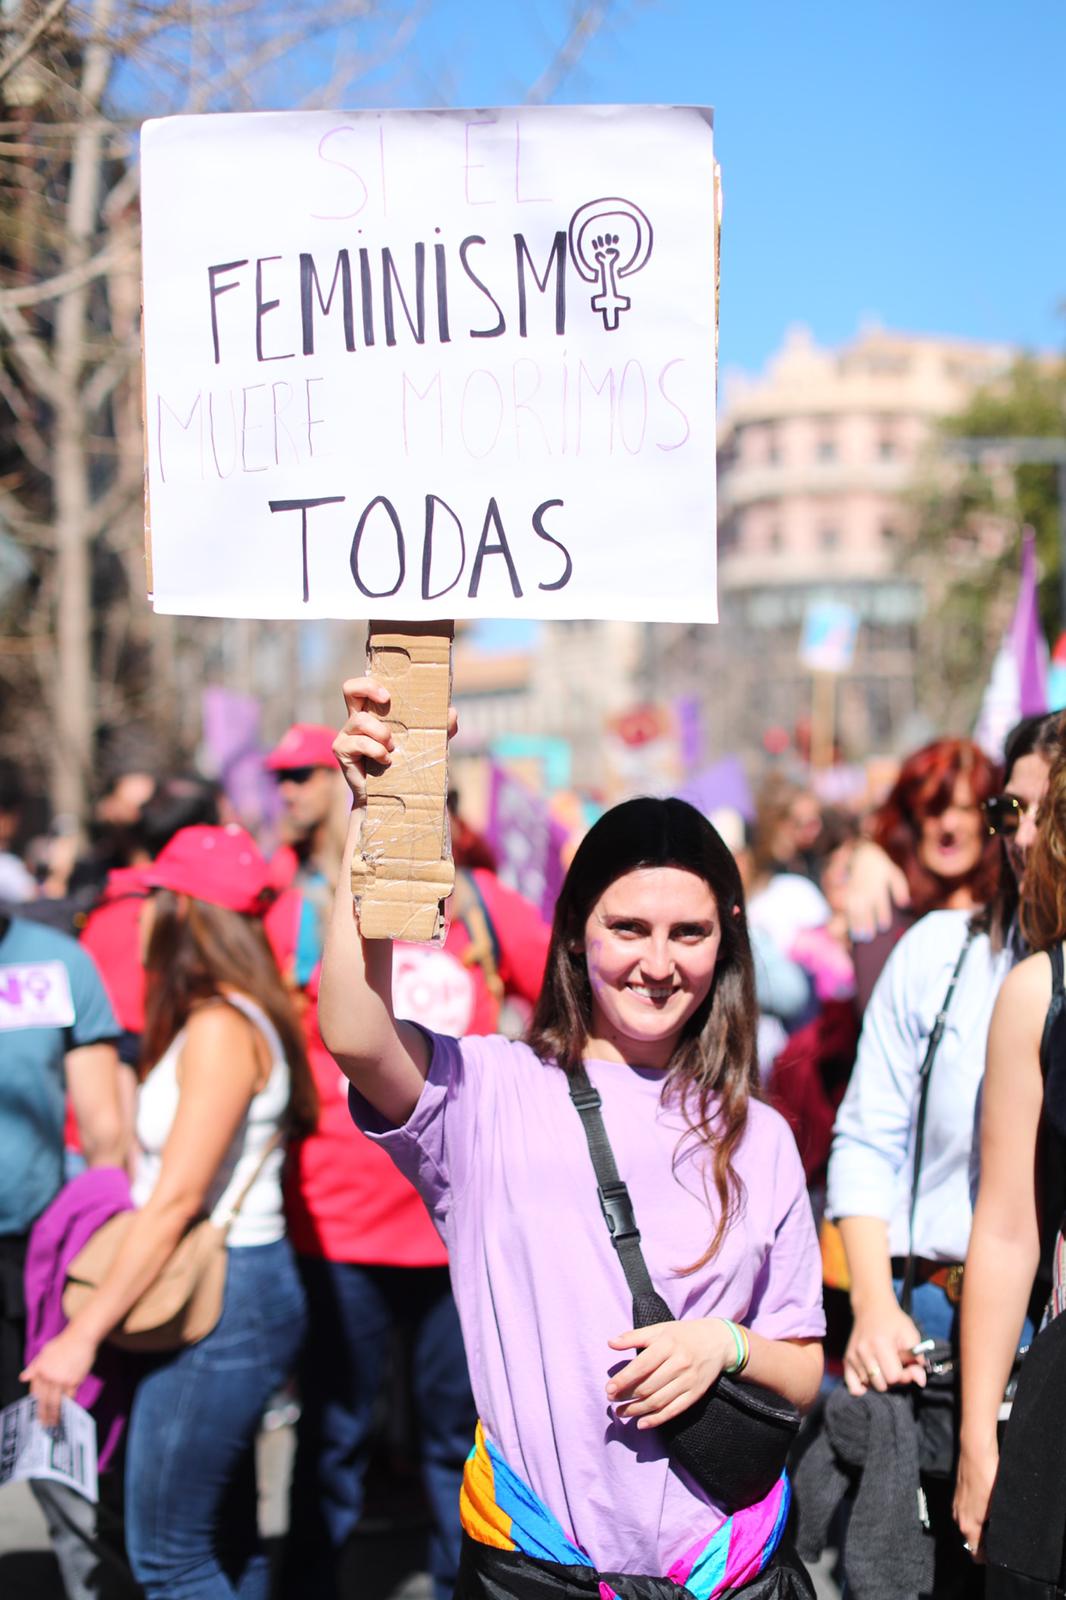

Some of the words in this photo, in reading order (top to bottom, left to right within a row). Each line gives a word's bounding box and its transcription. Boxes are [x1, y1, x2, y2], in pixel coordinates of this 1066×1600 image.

[310, 114, 387, 220] SI
[464, 120, 553, 205] EL
[402, 349, 690, 459] MORIMOS
[268, 493, 573, 603] TODAS
